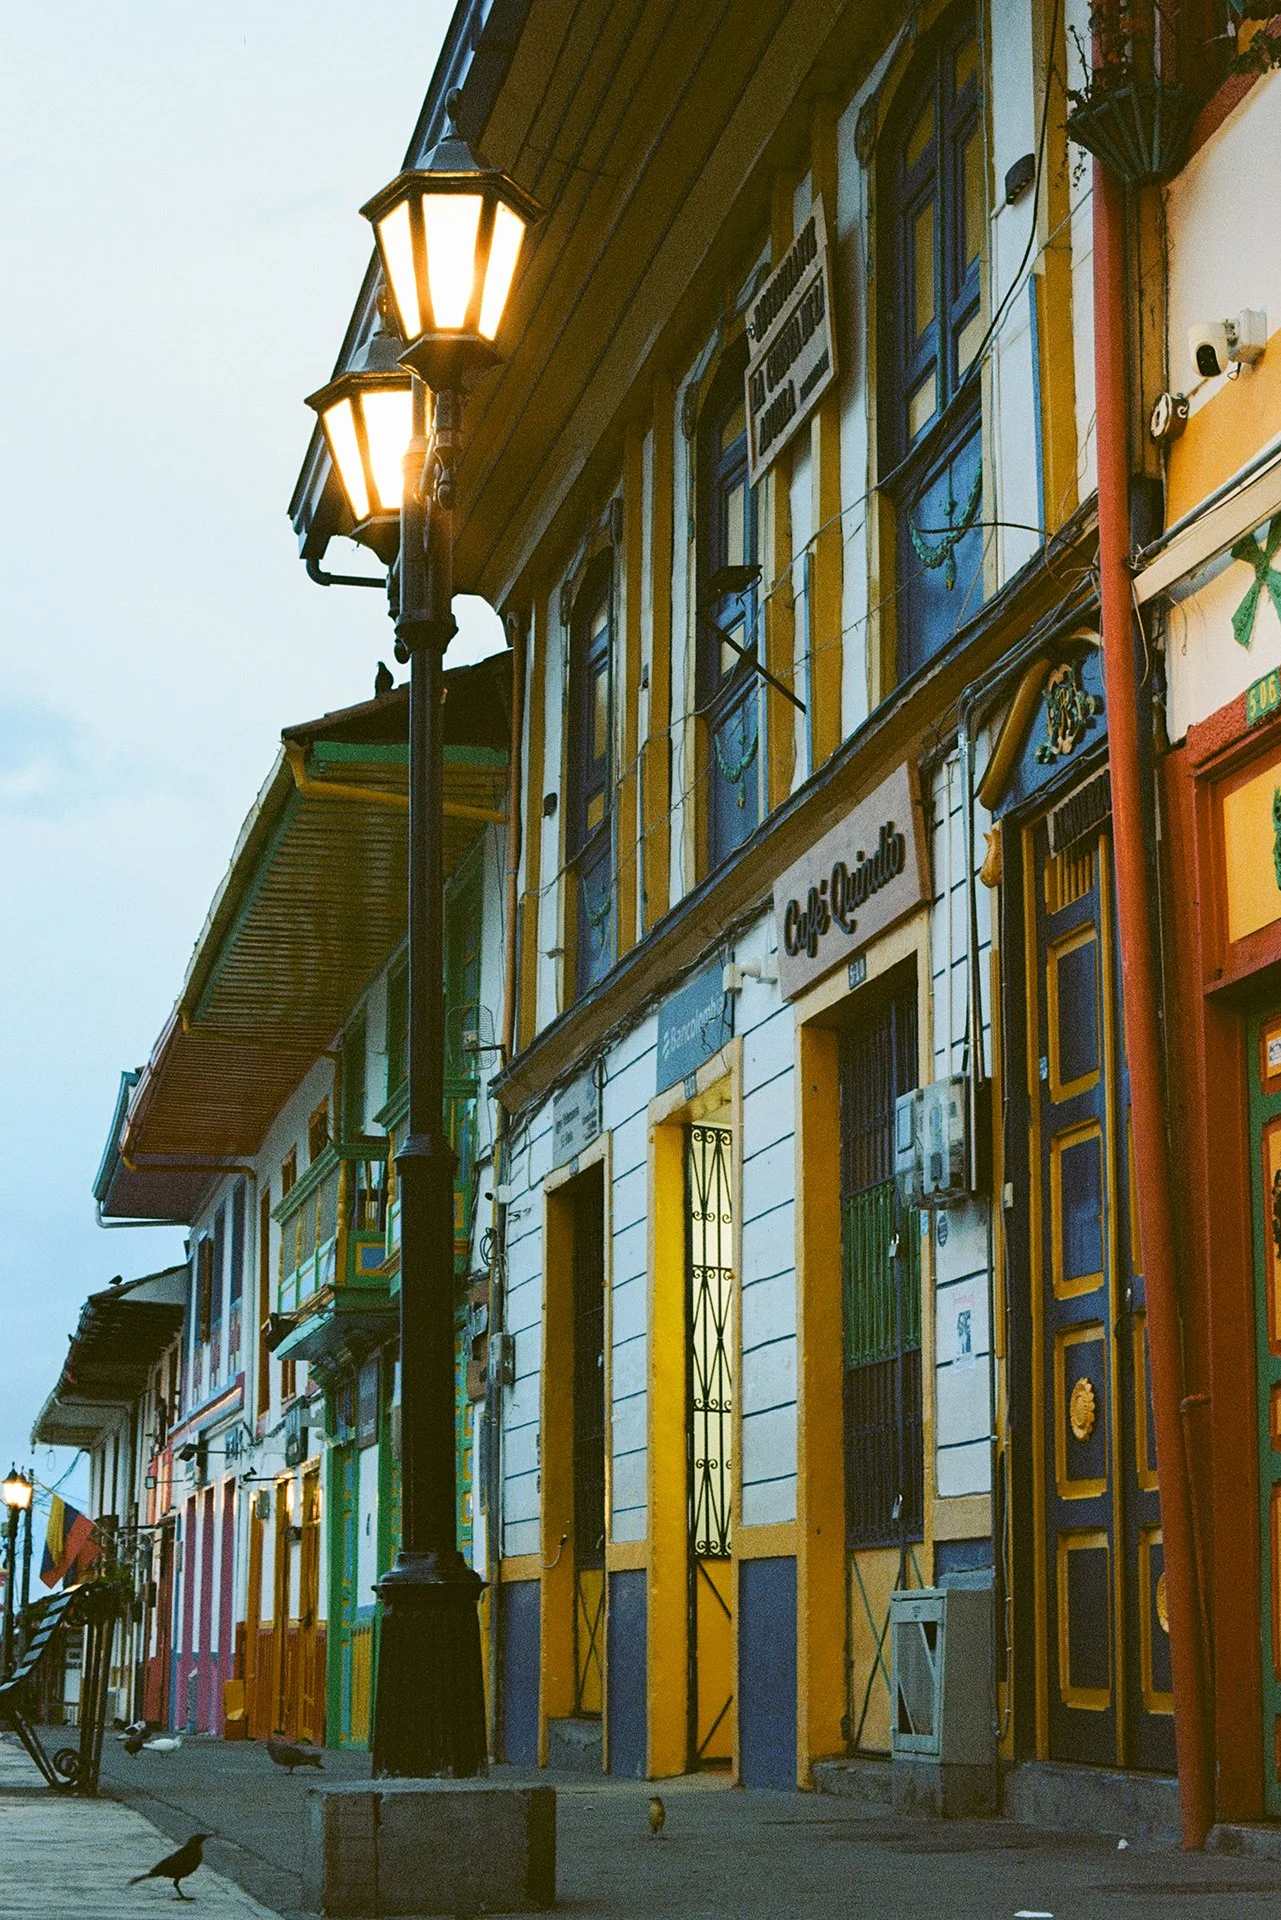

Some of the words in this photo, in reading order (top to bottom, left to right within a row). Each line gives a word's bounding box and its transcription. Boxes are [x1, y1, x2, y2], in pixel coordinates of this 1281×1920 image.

[1249, 673, 1277, 719] 506
[784, 879, 831, 958] Café
[830, 821, 906, 934] Quindío
